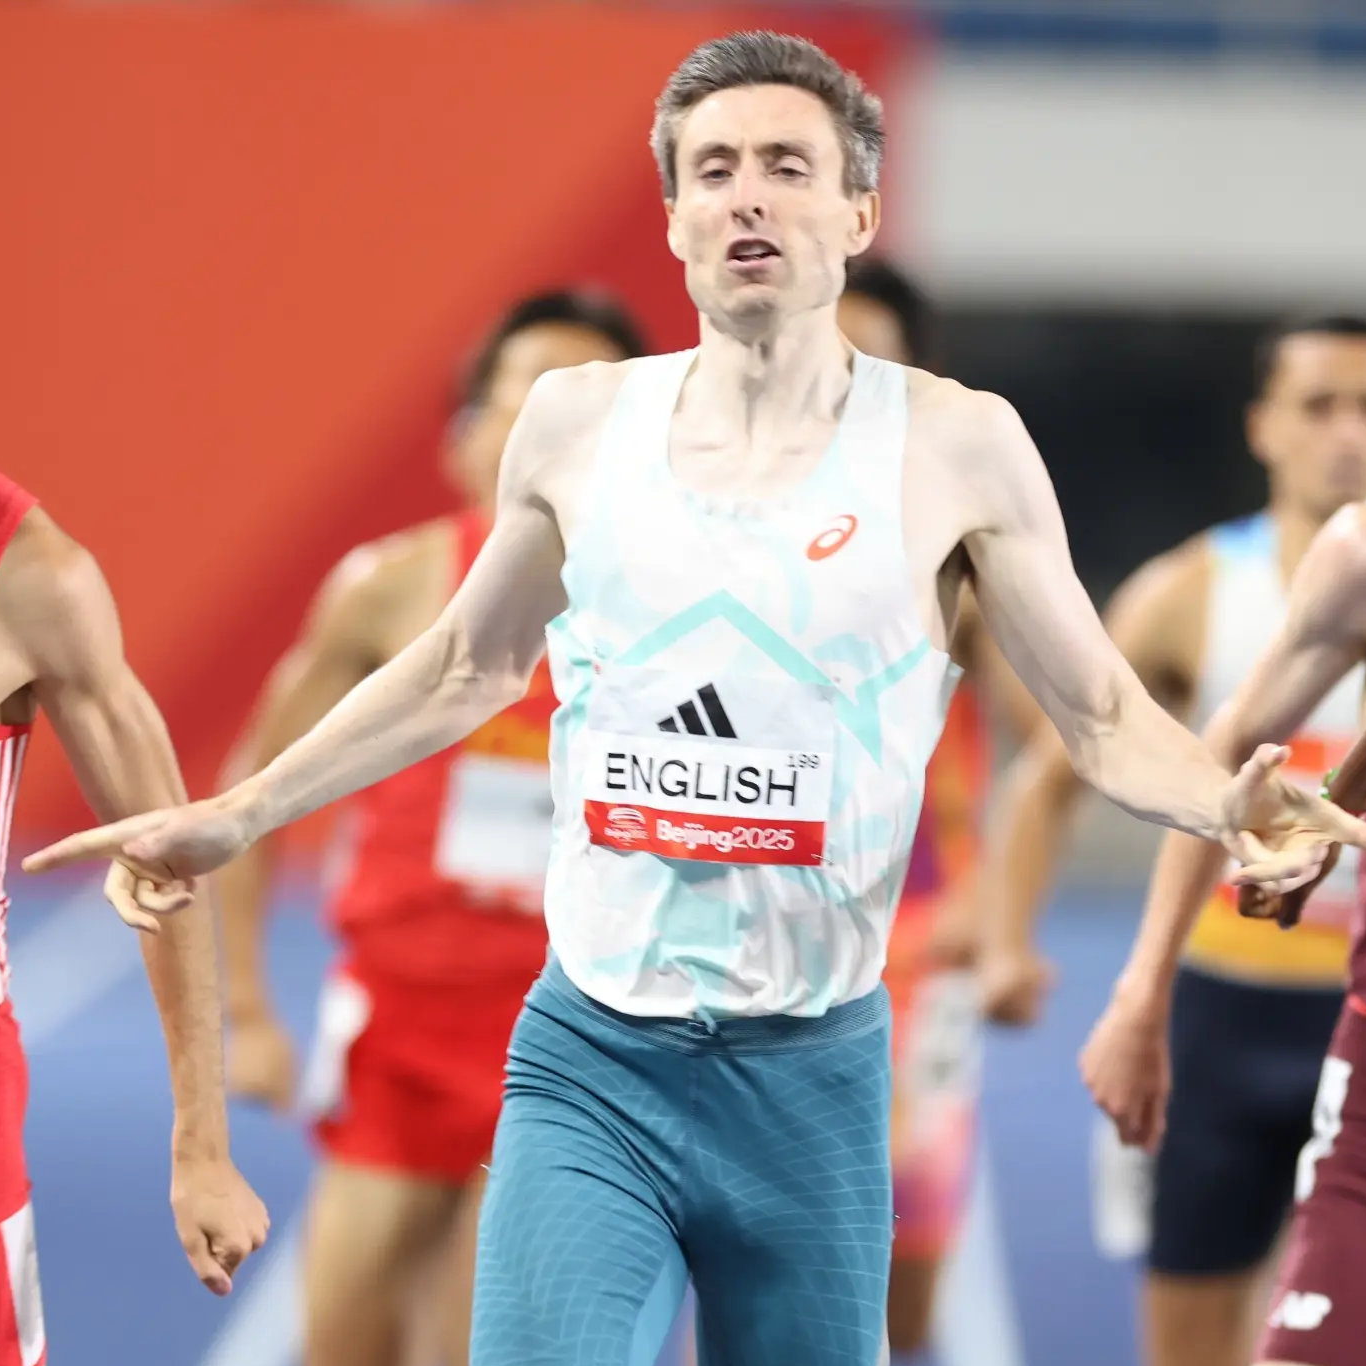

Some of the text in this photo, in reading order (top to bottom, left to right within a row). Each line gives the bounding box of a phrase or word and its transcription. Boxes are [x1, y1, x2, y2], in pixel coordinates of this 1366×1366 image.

[786, 752, 821, 770] 199
[605, 752, 800, 807] ENGLISH
[656, 818, 795, 853] Beijing2025
